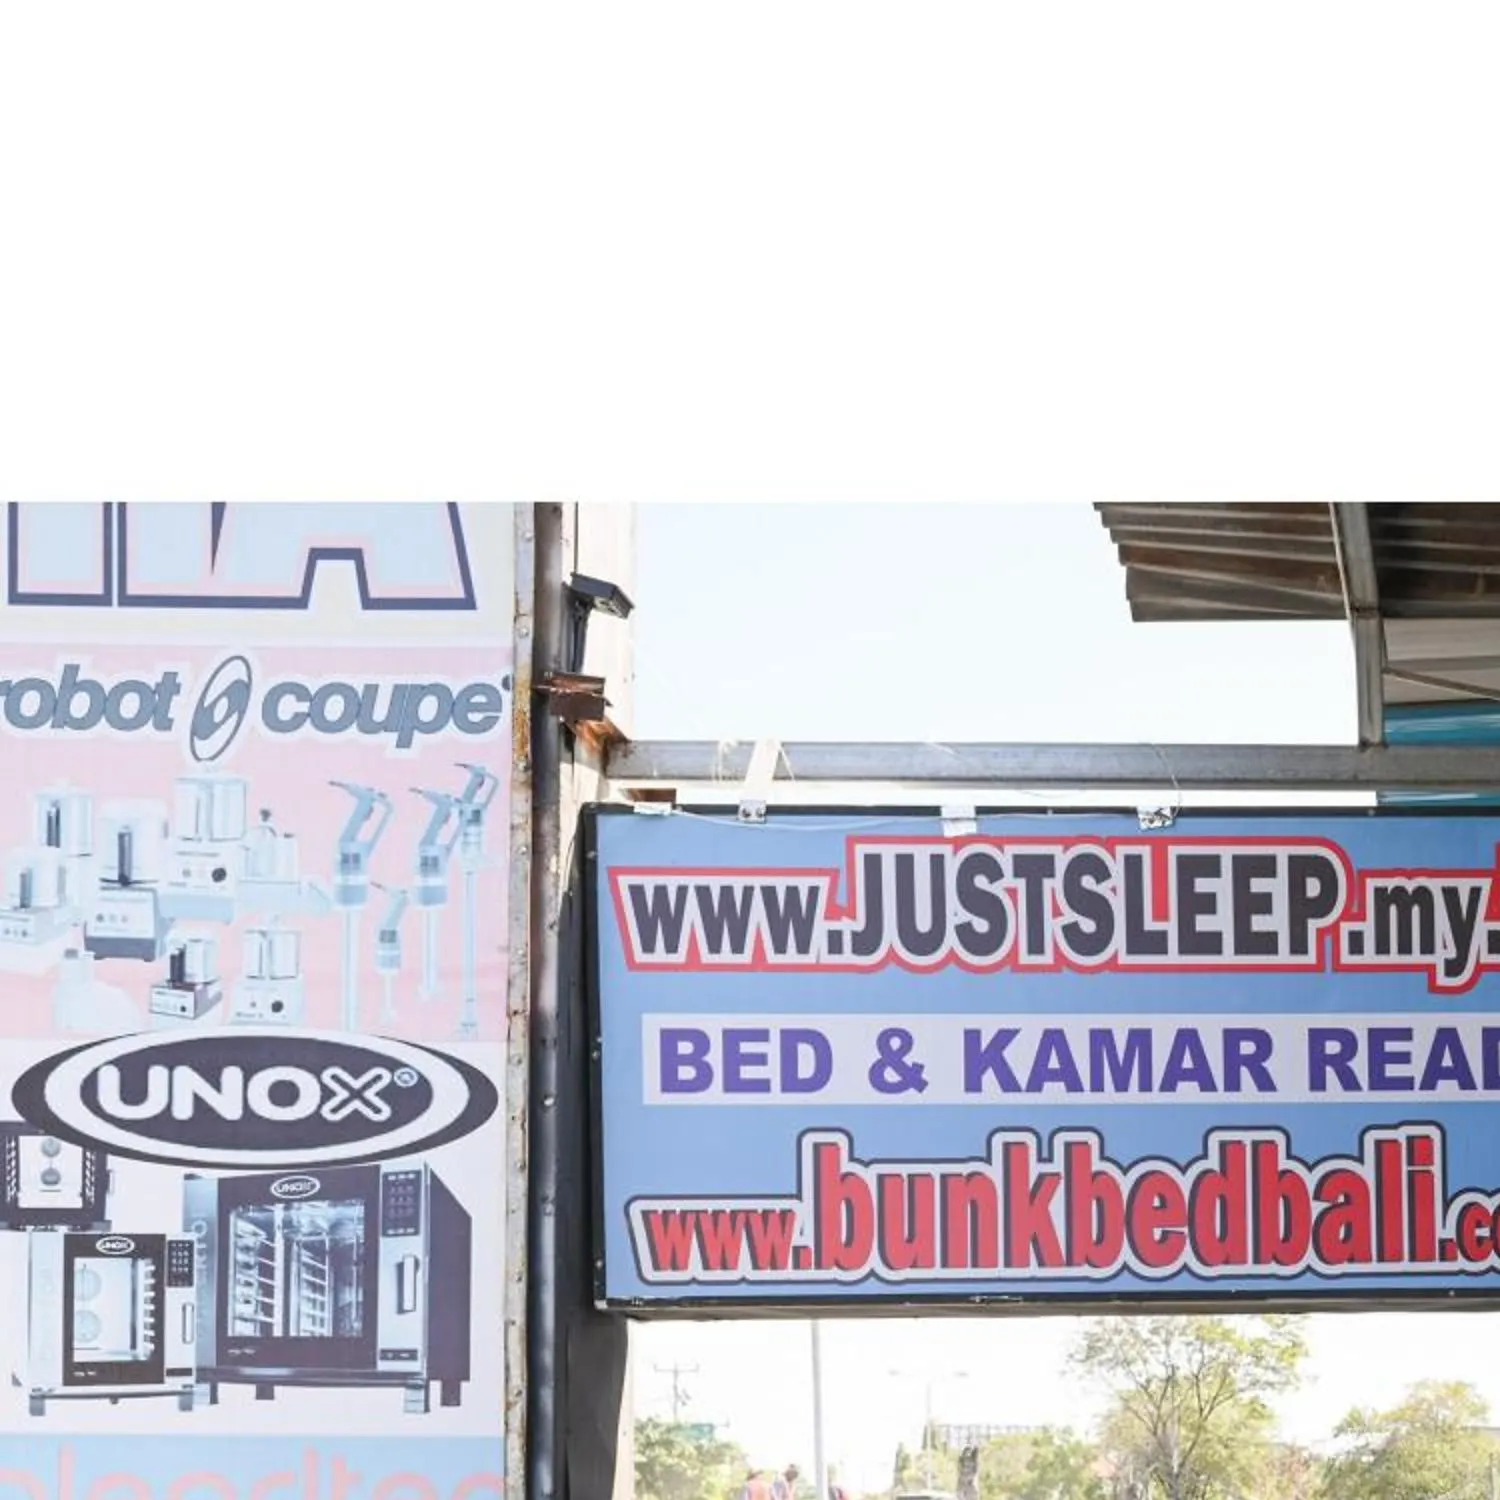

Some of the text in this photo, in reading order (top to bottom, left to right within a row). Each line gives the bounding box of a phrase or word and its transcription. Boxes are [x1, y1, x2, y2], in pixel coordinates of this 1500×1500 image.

[261, 680, 502, 748] coupe
[658, 1027, 834, 1094] BED
[867, 1027, 929, 1094] &
[963, 1028, 1277, 1093] KAMAR
